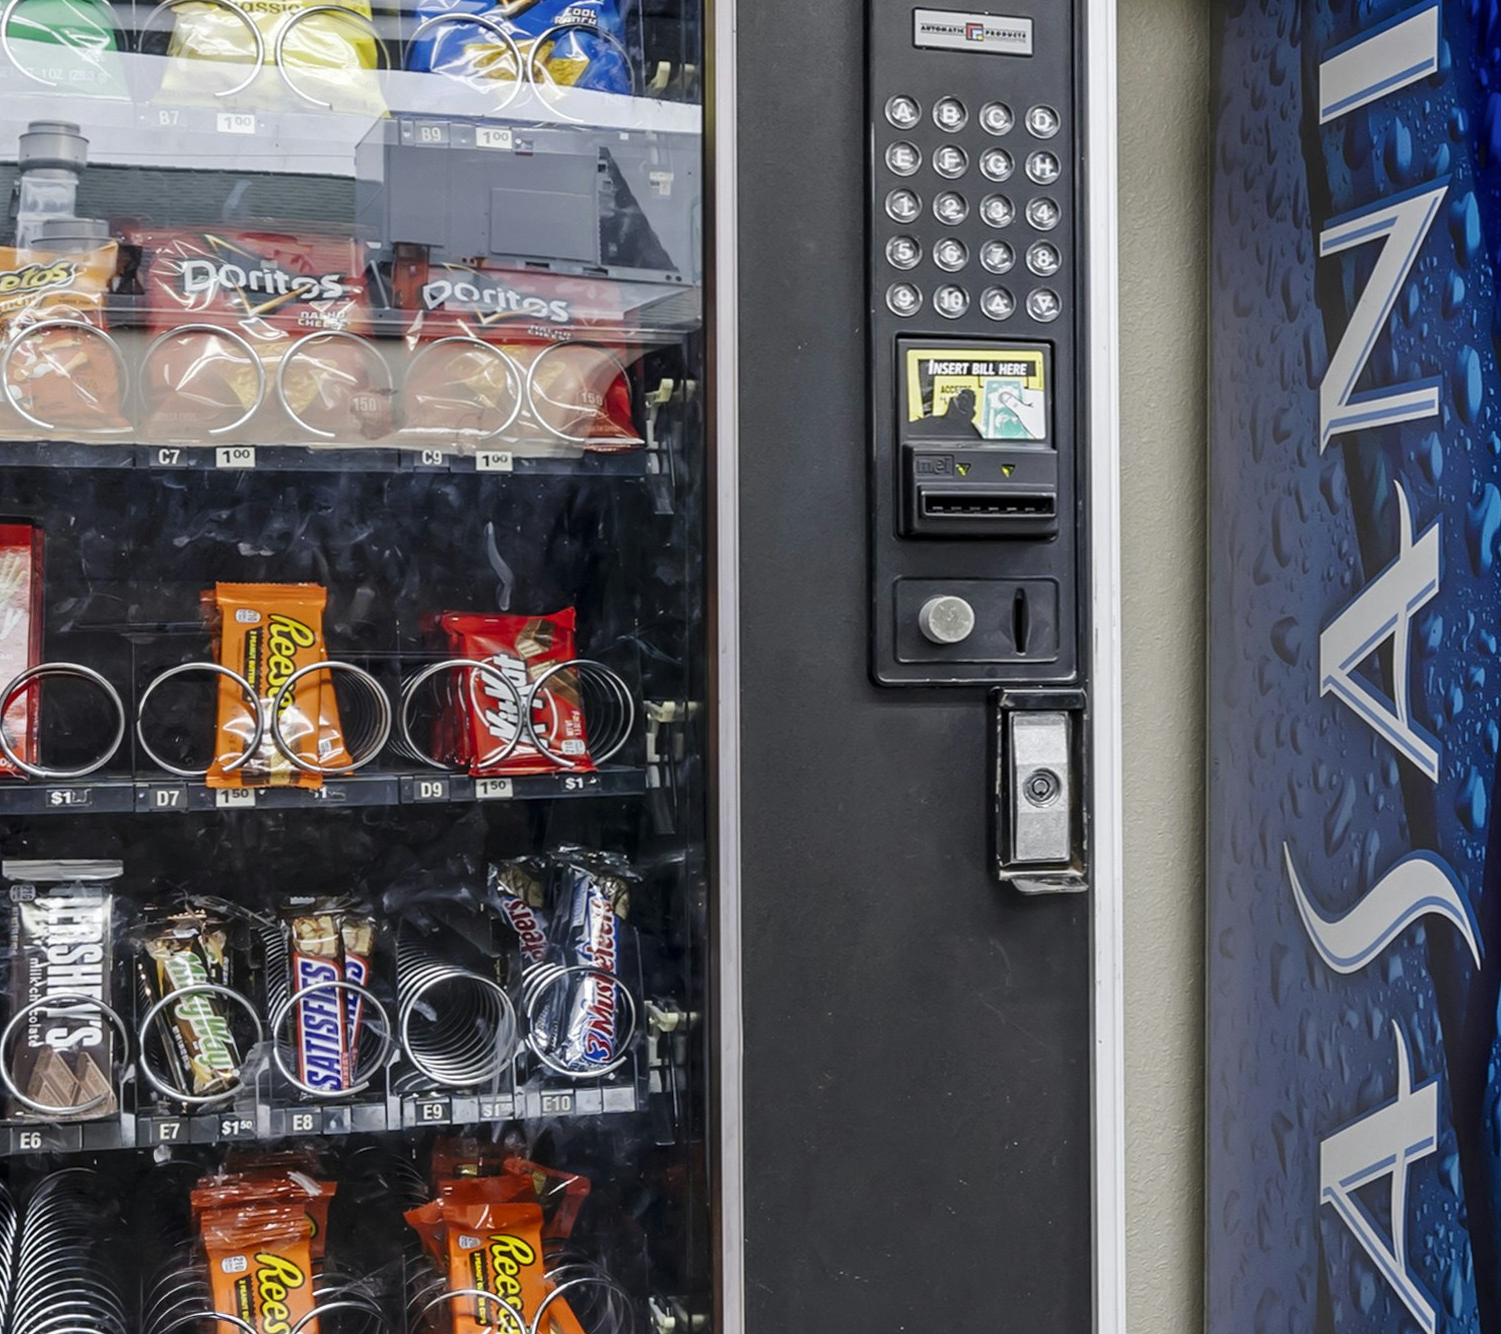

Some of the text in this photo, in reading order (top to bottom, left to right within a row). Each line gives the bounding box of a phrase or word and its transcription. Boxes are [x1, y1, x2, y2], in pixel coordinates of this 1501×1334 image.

[564, 6, 597, 17] COOL
[920, 25, 1027, 39] AUTOMATIC PRODUCTS
[183, 259, 343, 300] Doritos
[423, 280, 571, 323] Doritos
[942, 291, 963, 307] 10
[928, 358, 1028, 376] INSERT BILL HERE
[420, 781, 443, 797] D9
[28, 958, 44, 987] milk
[298, 960, 342, 1091] SATISFIES
[293, 1115, 314, 1131] E8
[19, 1132, 41, 1149] E6
